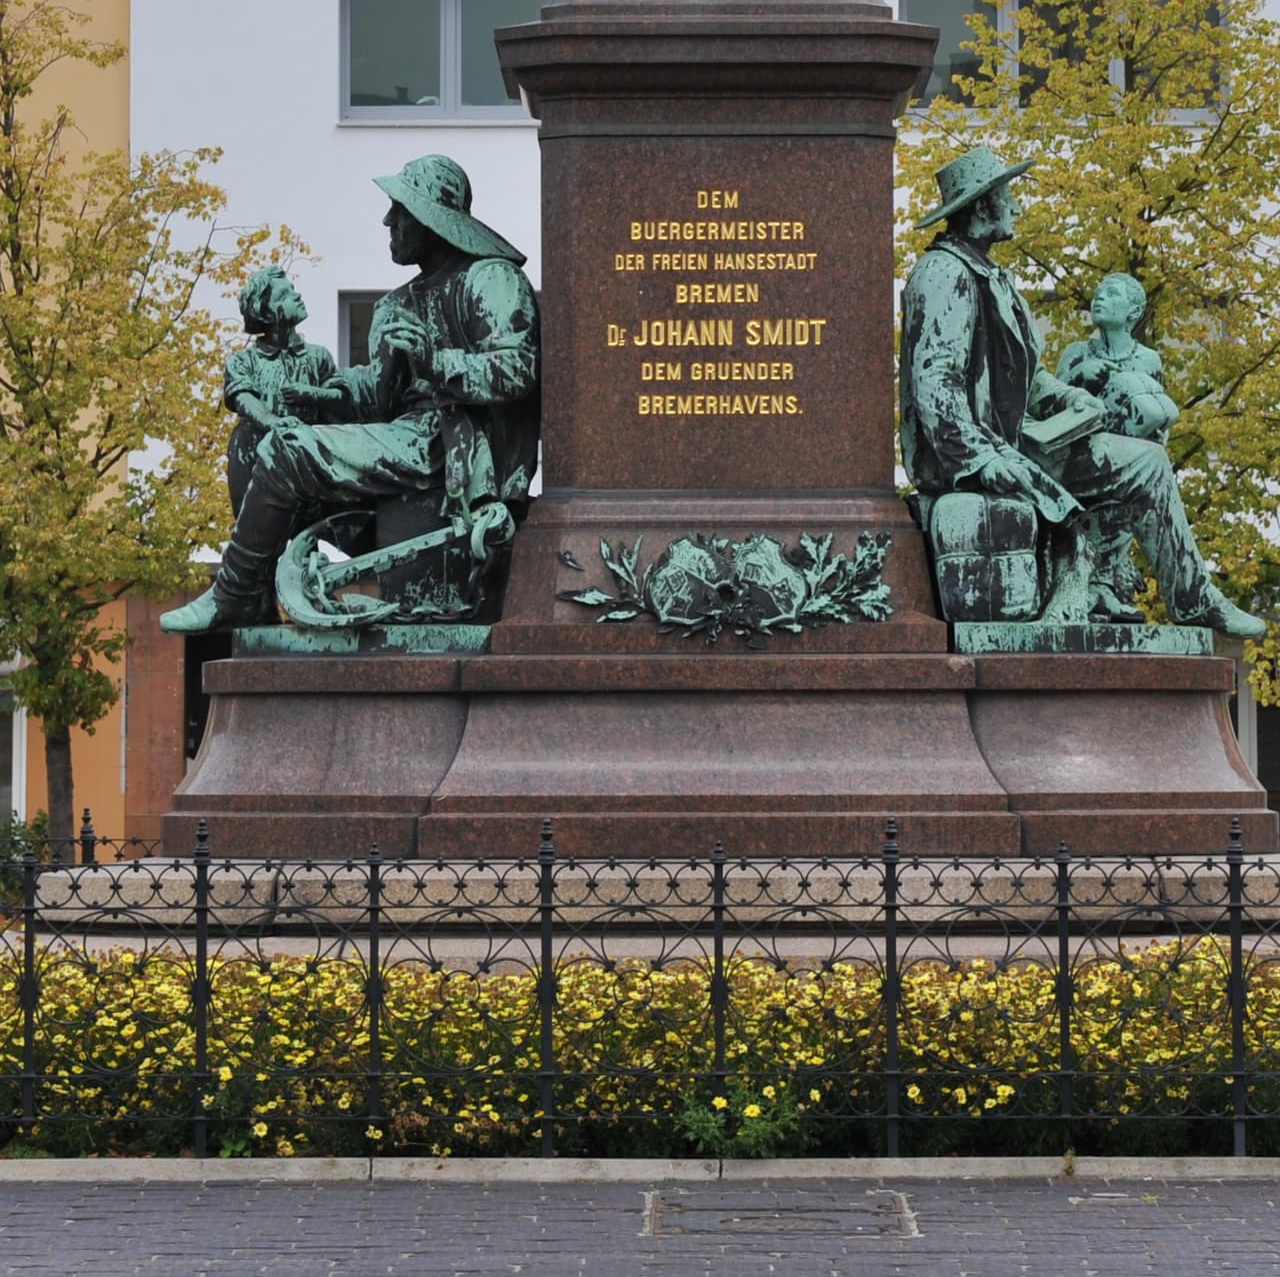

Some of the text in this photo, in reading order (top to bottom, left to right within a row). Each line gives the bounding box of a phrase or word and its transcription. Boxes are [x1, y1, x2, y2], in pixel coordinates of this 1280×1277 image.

[697, 190, 739, 209] DEM
[630, 222, 805, 240] BUERGERMEISTER
[615, 253, 817, 270] DER FREIEN HANSESTADT
[676, 283, 759, 303] BREMEN
[634, 320, 733, 346] JOHANN
[746, 320, 826, 346] SMIDT
[641, 363, 794, 381] DEM GRUENDER
[638, 395, 804, 415] BREMERHAVENS.
